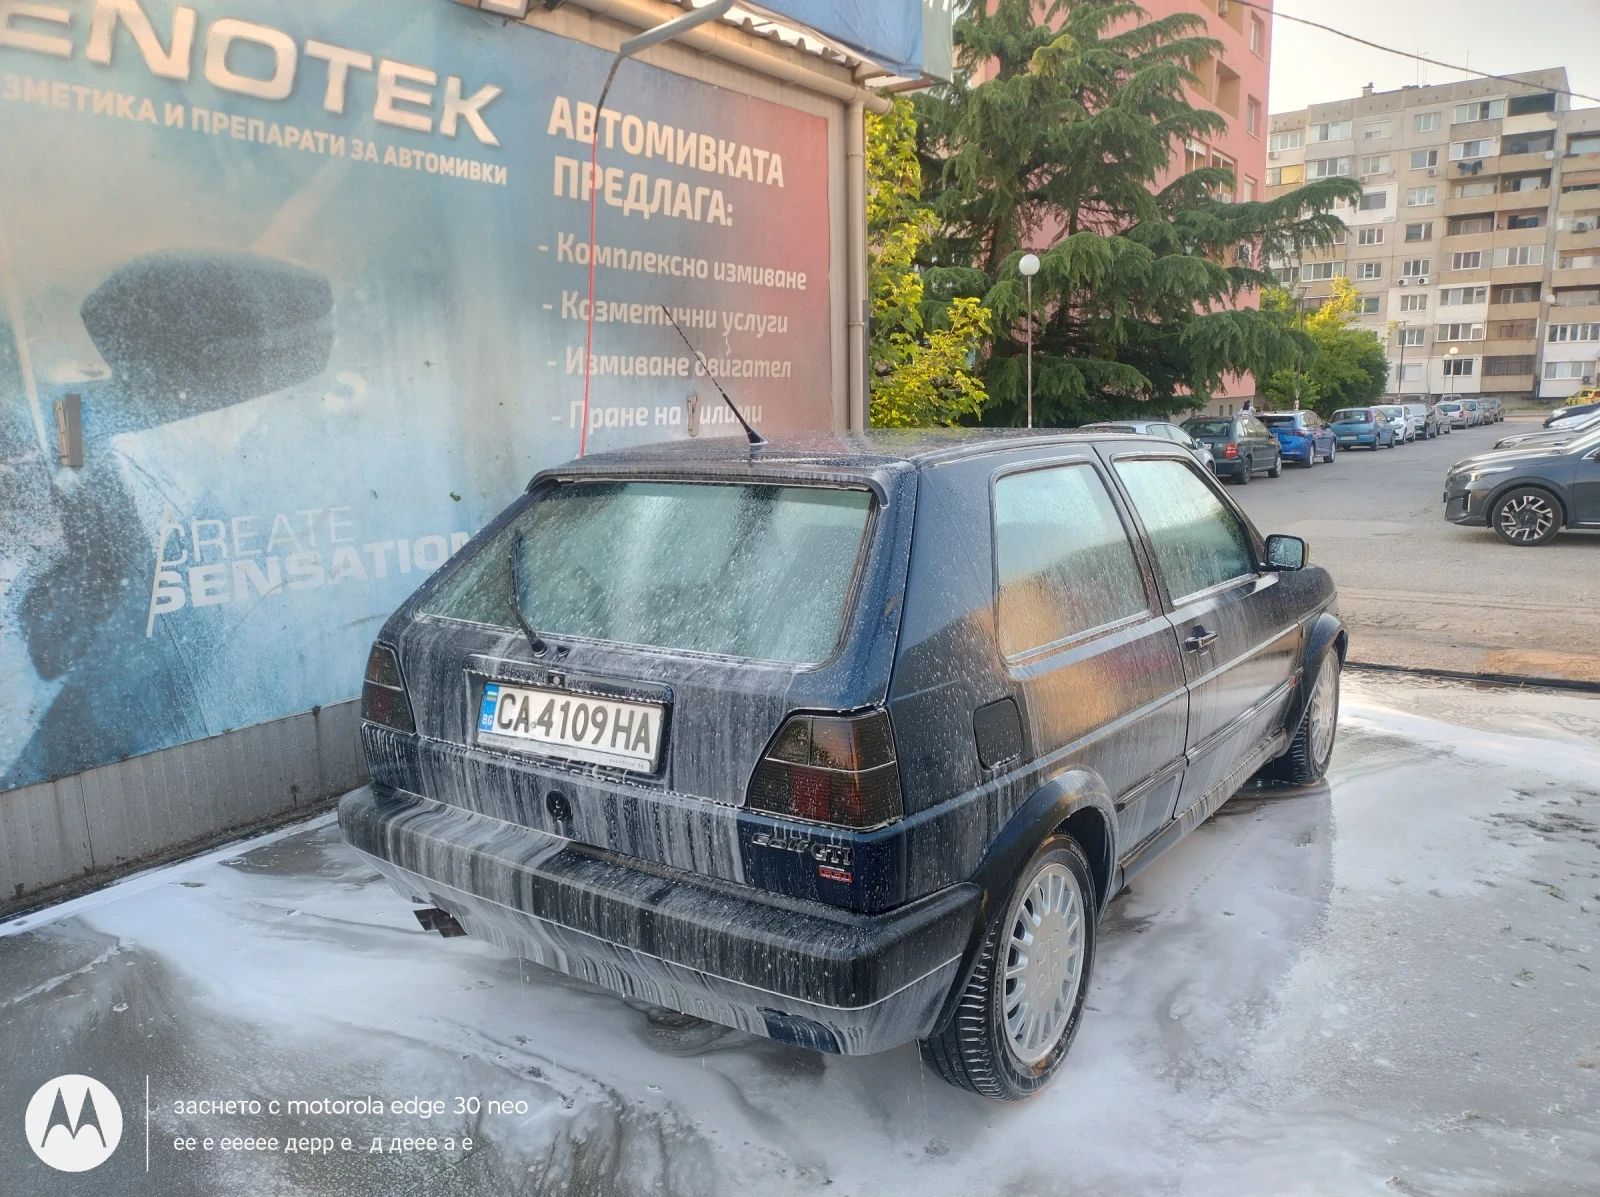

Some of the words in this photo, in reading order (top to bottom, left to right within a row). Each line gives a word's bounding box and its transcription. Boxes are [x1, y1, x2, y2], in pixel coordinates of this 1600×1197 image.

[164, 102, 185, 129] И
[191, 108, 347, 158] ПРЕПАРАТИ
[351, 139, 380, 164] ЗА
[383, 146, 508, 186] АВТОМИВКИ
[547, 96, 784, 188] АВТОМИВКАТА
[554, 156, 733, 226] ПРЕДЛАГА:
[557, 232, 708, 279] Комплексно
[714, 262, 807, 290] измиване
[561, 290, 717, 329] Козметични
[722, 310, 788, 338] услуги
[566, 346, 690, 376] Измиване
[694, 351, 791, 378] двигател
[570, 401, 648, 434] Пране
[654, 406, 681, 426] на
[686, 402, 762, 424] илими
[161, 506, 355, 568] CREATE
[482, 713, 493, 726] BG
[811, 841, 851, 866] GTI
